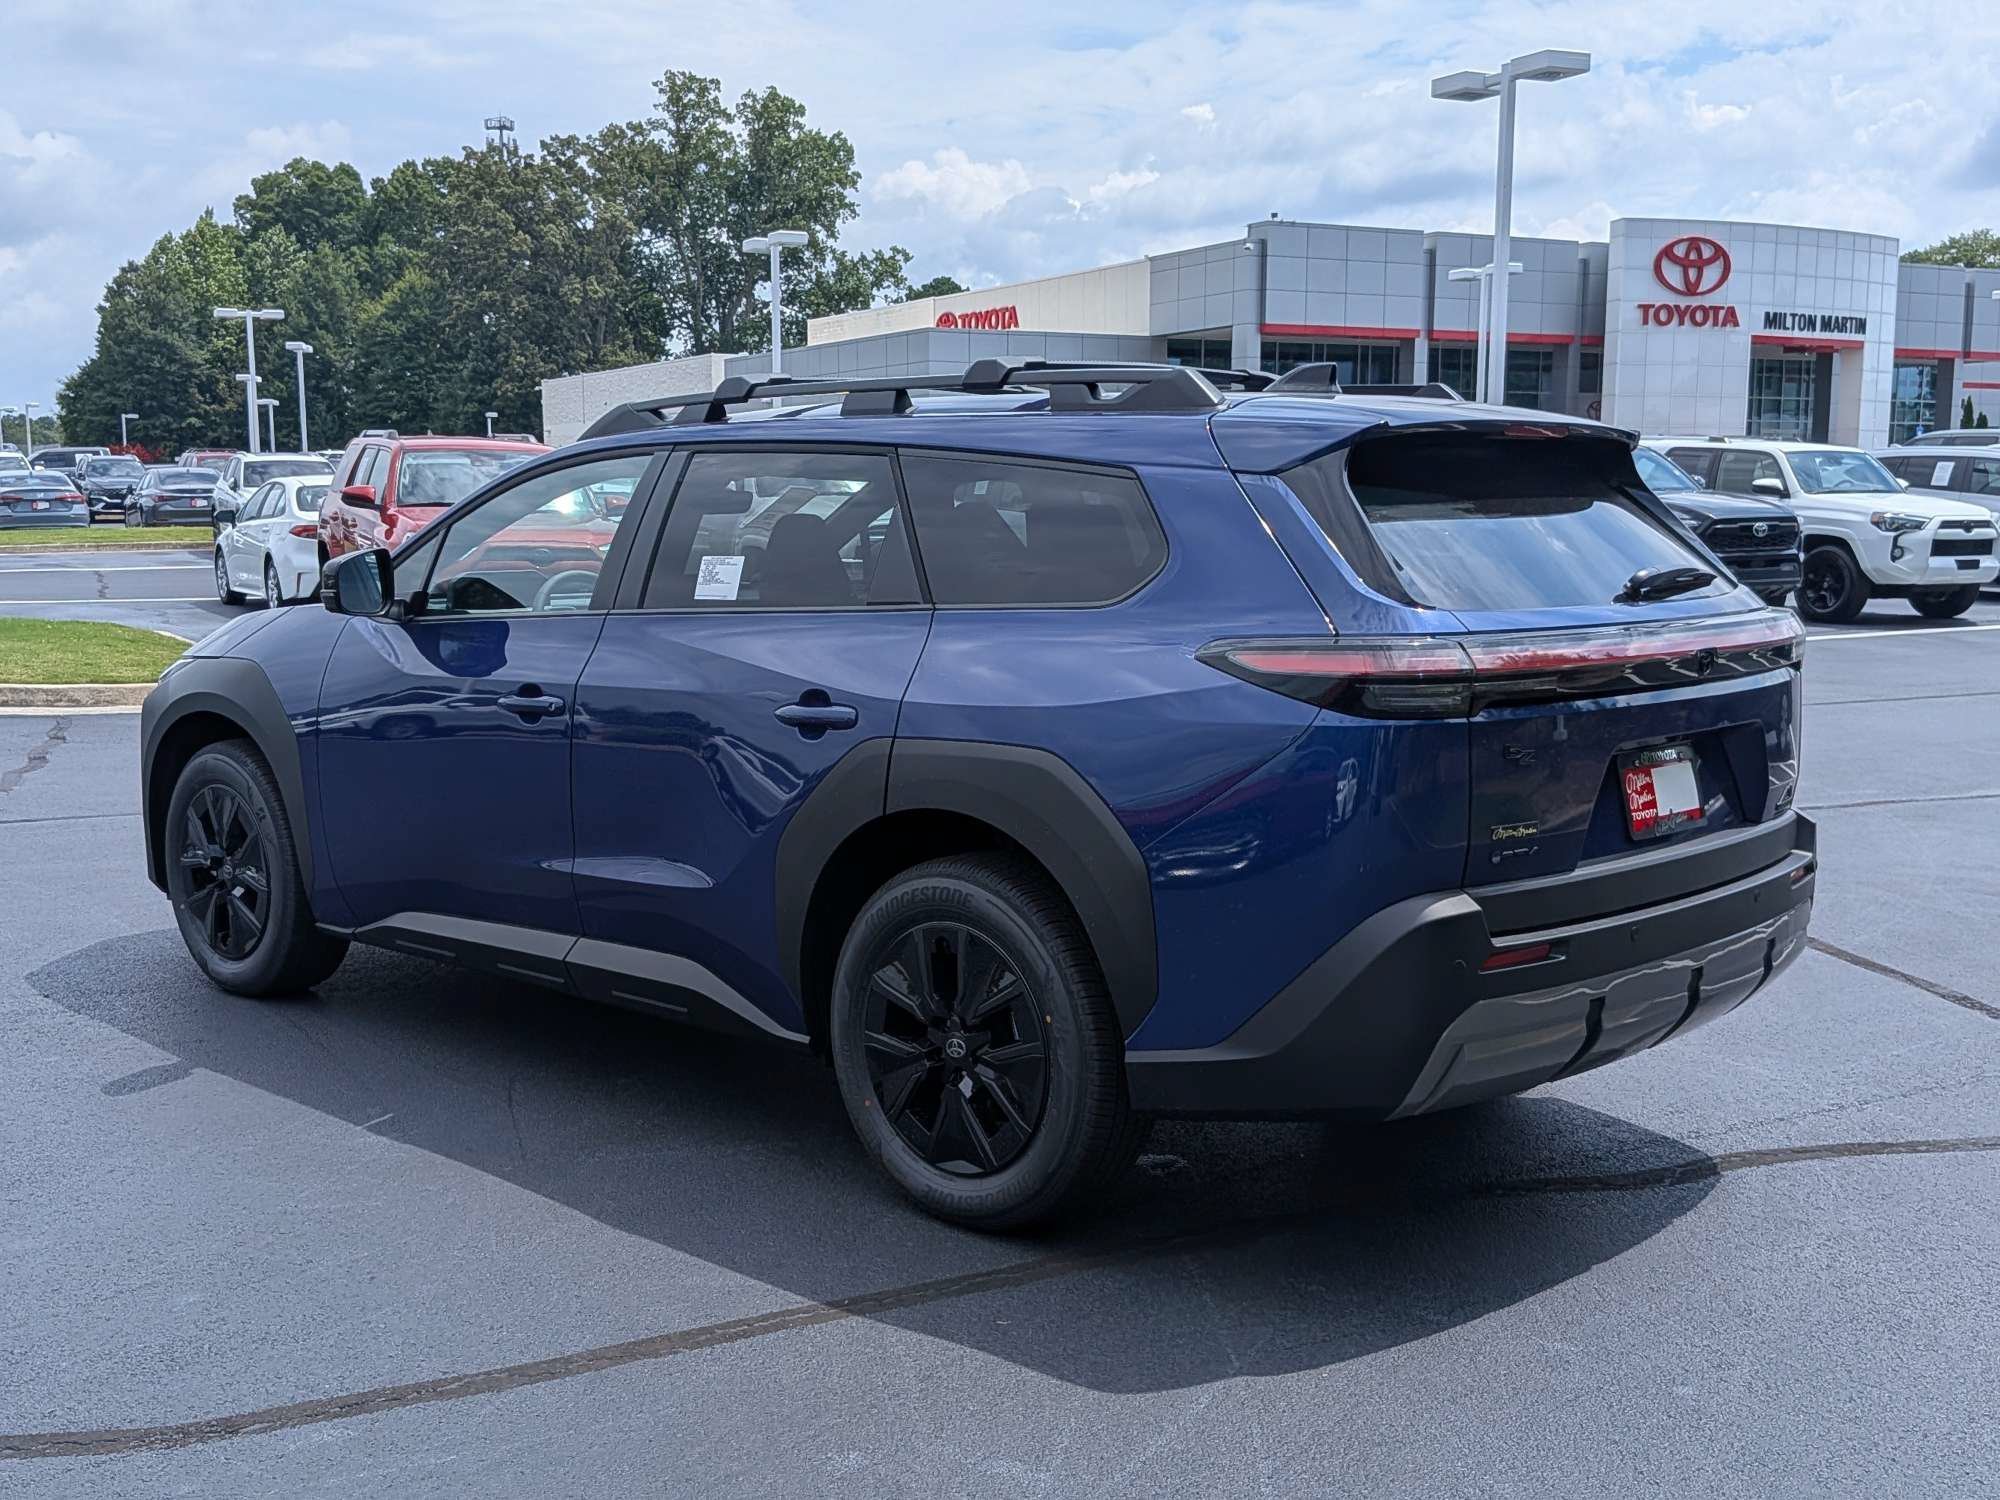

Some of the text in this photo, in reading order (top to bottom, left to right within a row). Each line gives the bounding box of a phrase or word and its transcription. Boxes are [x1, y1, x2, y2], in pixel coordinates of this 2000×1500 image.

[958, 305, 1019, 329] TOYOTA
[1637, 303, 1740, 327] TOYOTA
[1763, 311, 1867, 335] MILTON MARTIN
[1631, 808, 1657, 821] TOYOTA
